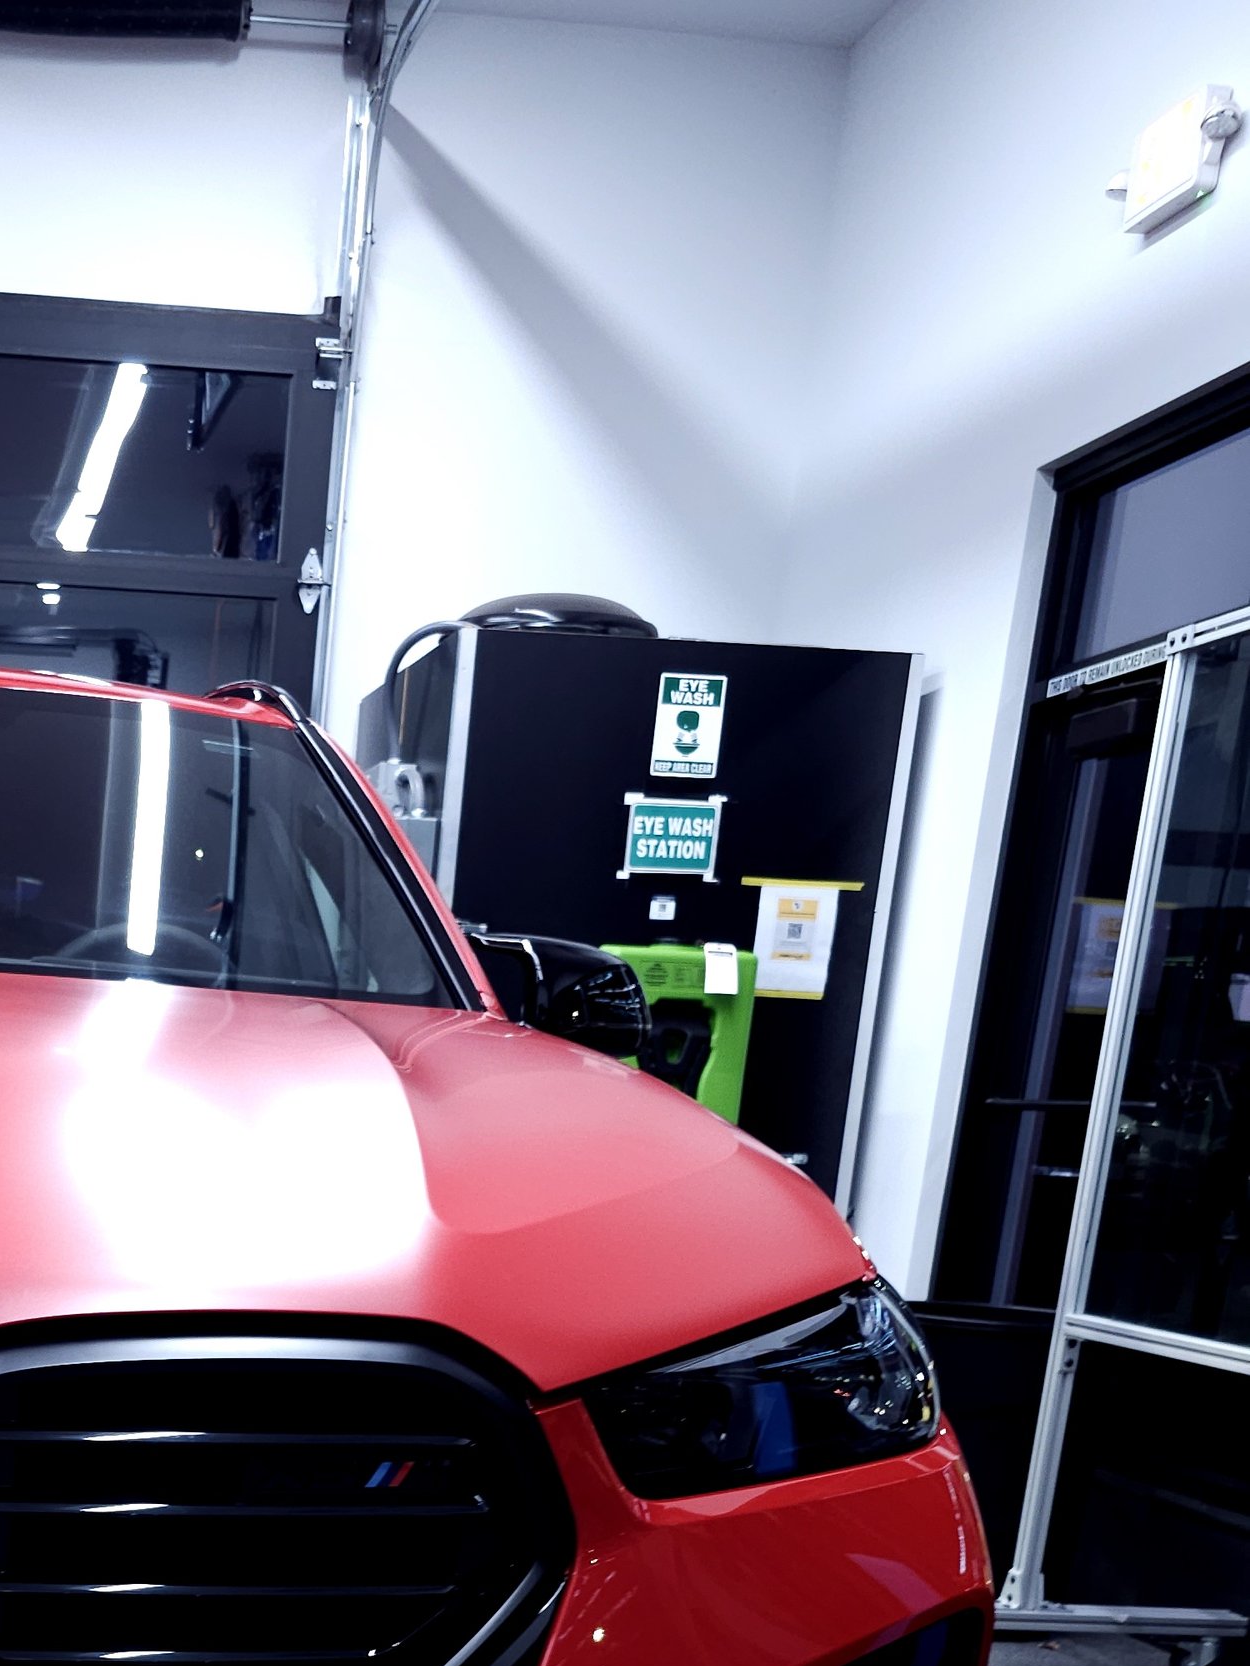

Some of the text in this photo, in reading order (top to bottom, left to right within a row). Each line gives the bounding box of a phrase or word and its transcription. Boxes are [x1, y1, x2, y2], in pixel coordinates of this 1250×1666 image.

[1088, 664, 1109, 681] REMAIN
[1110, 653, 1142, 674] UNLOCKED
[679, 679, 709, 692] EYE
[670, 690, 715, 705] WASH
[654, 761, 712, 775] KEEP AREA CLEAR
[633, 816, 714, 837] EYE WASH
[636, 838, 706, 859] STATION
